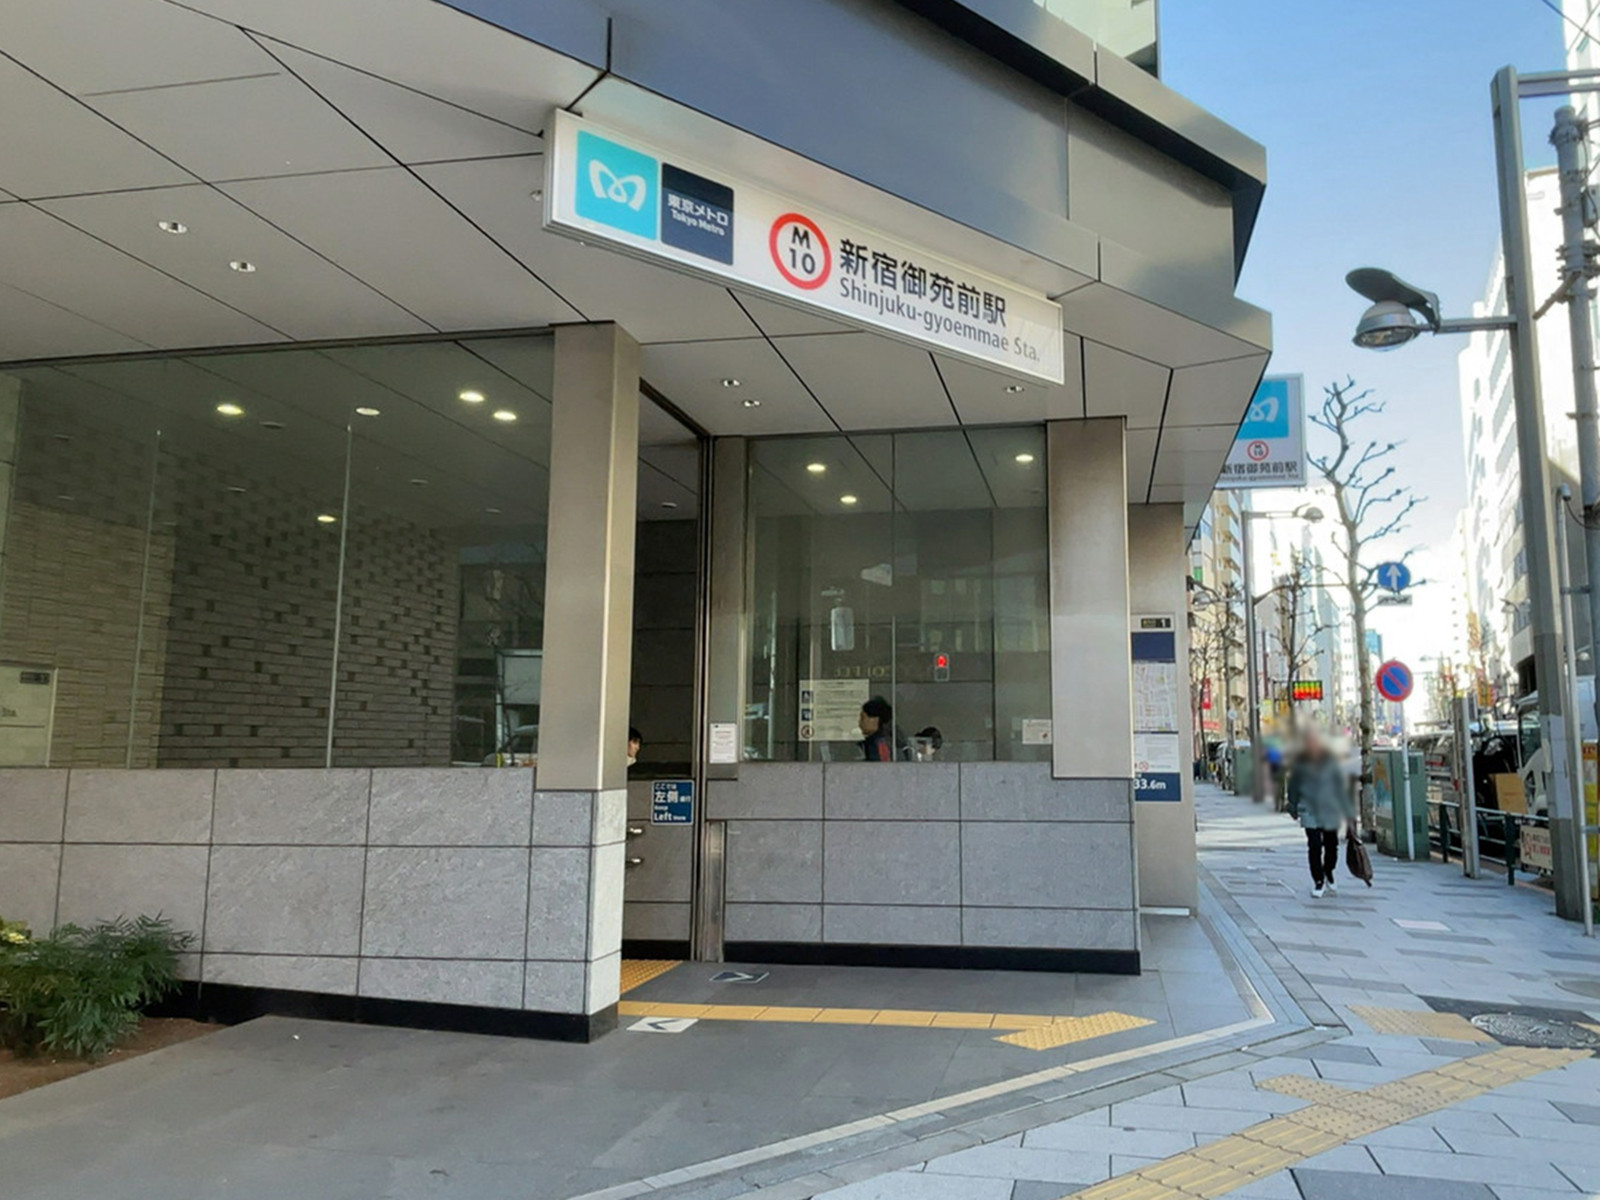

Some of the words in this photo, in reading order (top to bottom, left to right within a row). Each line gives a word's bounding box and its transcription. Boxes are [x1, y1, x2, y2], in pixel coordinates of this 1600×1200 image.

[667, 193, 729, 227] 東京メトロ
[670, 209, 697, 228] Tokyo
[698, 219, 725, 236] Metro
[791, 225, 812, 250] M
[789, 248, 816, 275] 10
[840, 238, 1007, 328] 新宿御苑前駅
[840, 276, 1010, 351] Shinjuku-gyoemmae
[1014, 337, 1041, 362] Sta.
[654, 812, 672, 821] Left
